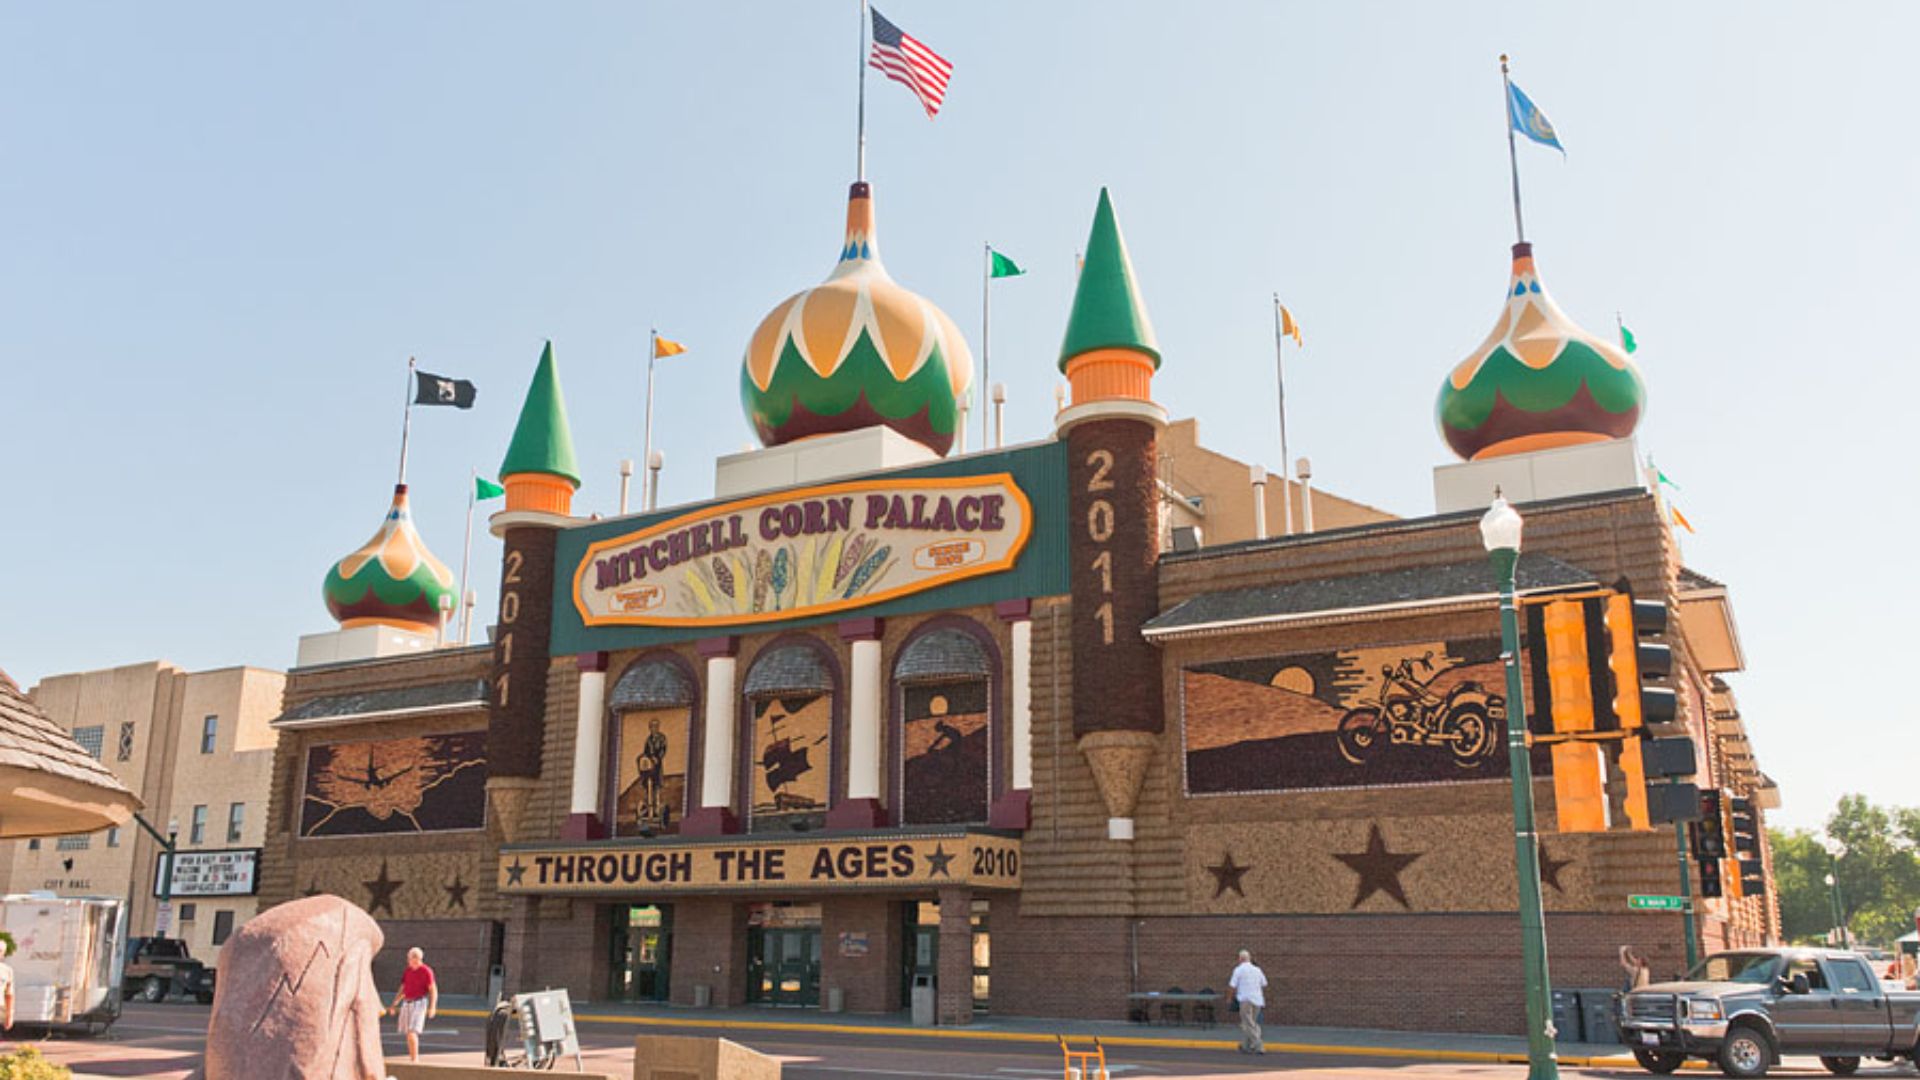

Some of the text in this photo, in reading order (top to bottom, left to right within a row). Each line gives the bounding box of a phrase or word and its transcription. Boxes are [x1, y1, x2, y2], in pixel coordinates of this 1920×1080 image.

[595, 494, 1005, 591] MITCHELL CORN PALACE
[1086, 449, 1115, 645] 2011
[496, 550, 524, 707] 2011
[44, 879, 64, 889] CITY
[535, 844, 914, 884] THROUGH THE AGES
[972, 846, 1018, 877] 2010
